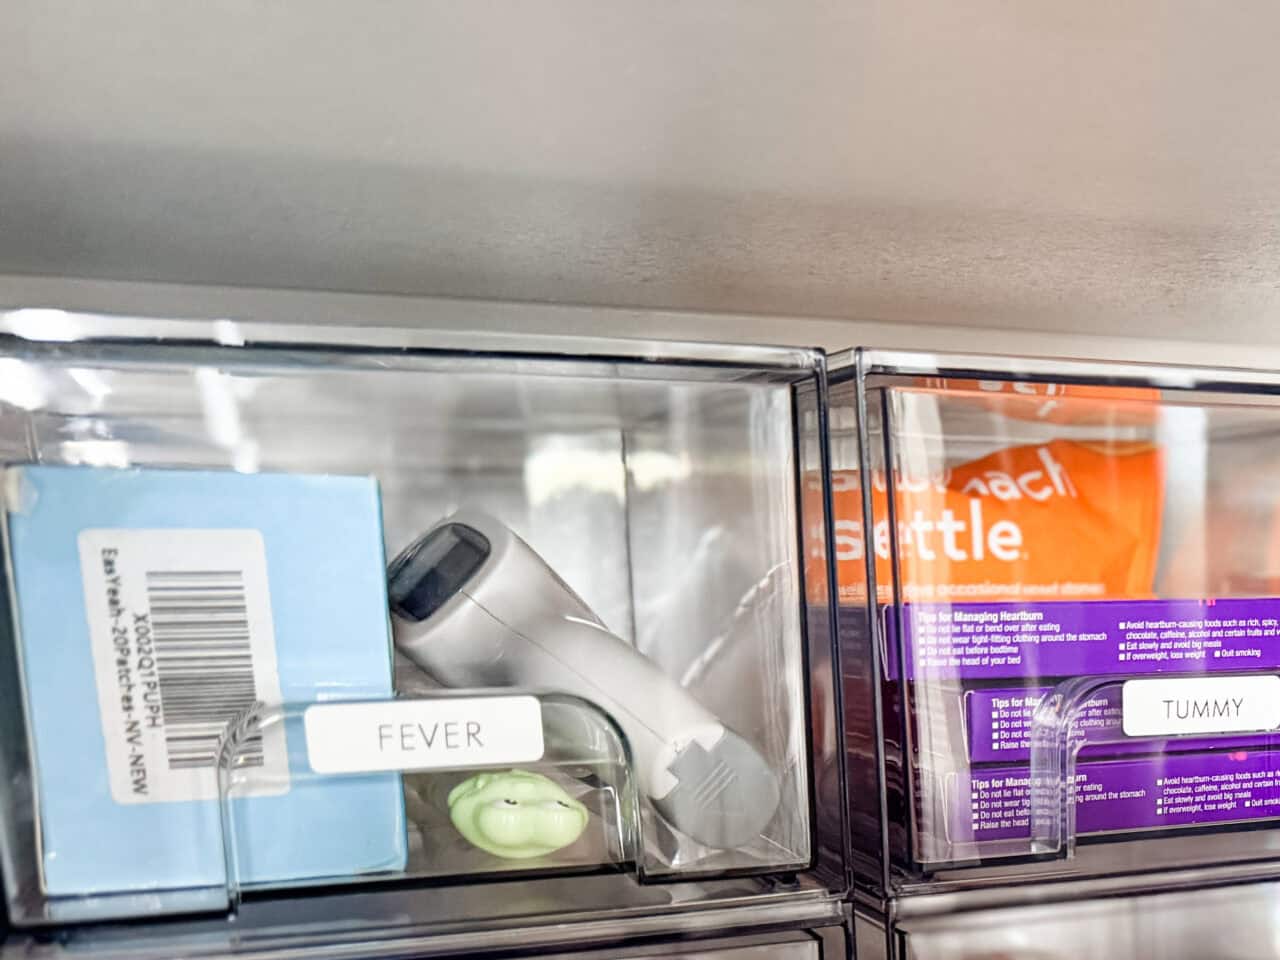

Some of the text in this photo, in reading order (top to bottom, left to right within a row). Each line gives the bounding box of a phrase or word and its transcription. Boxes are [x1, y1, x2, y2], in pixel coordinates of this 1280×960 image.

[954, 611, 1043, 623] Managing Heartburn
[985, 624, 1003, 632] bend
[1021, 623, 1037, 632] after
[1039, 623, 1060, 632] eating
[1127, 621, 1144, 629] Avoid
[1079, 632, 1107, 641] stomach
[133, 613, 162, 728] X002Q1PUPH
[992, 697, 1009, 708] Tips
[1012, 697, 1023, 707] for
[1162, 698, 1243, 719] TUMMY
[1000, 710, 1021, 718] Do not
[1000, 720, 1022, 728] Do not
[378, 721, 484, 751] FEVER
[1000, 730, 1022, 739] Do not
[1164, 771, 1266, 785] Avoid heartburn-causing foods such
[972, 778, 1003, 790] Tips for
[1083, 783, 1102, 791] eating
[1221, 779, 1274, 791] alcohol and certain
[980, 790, 1002, 799] Do not
[1085, 789, 1146, 801] around the stomach
[1163, 792, 1233, 805] Eat and avoid big
[980, 800, 1002, 809] Do not
[1218, 801, 1236, 810] weight
[1251, 799, 1263, 807] Quit
[980, 809, 1014, 819] Do not eat
[980, 818, 1029, 830] Raise the head
